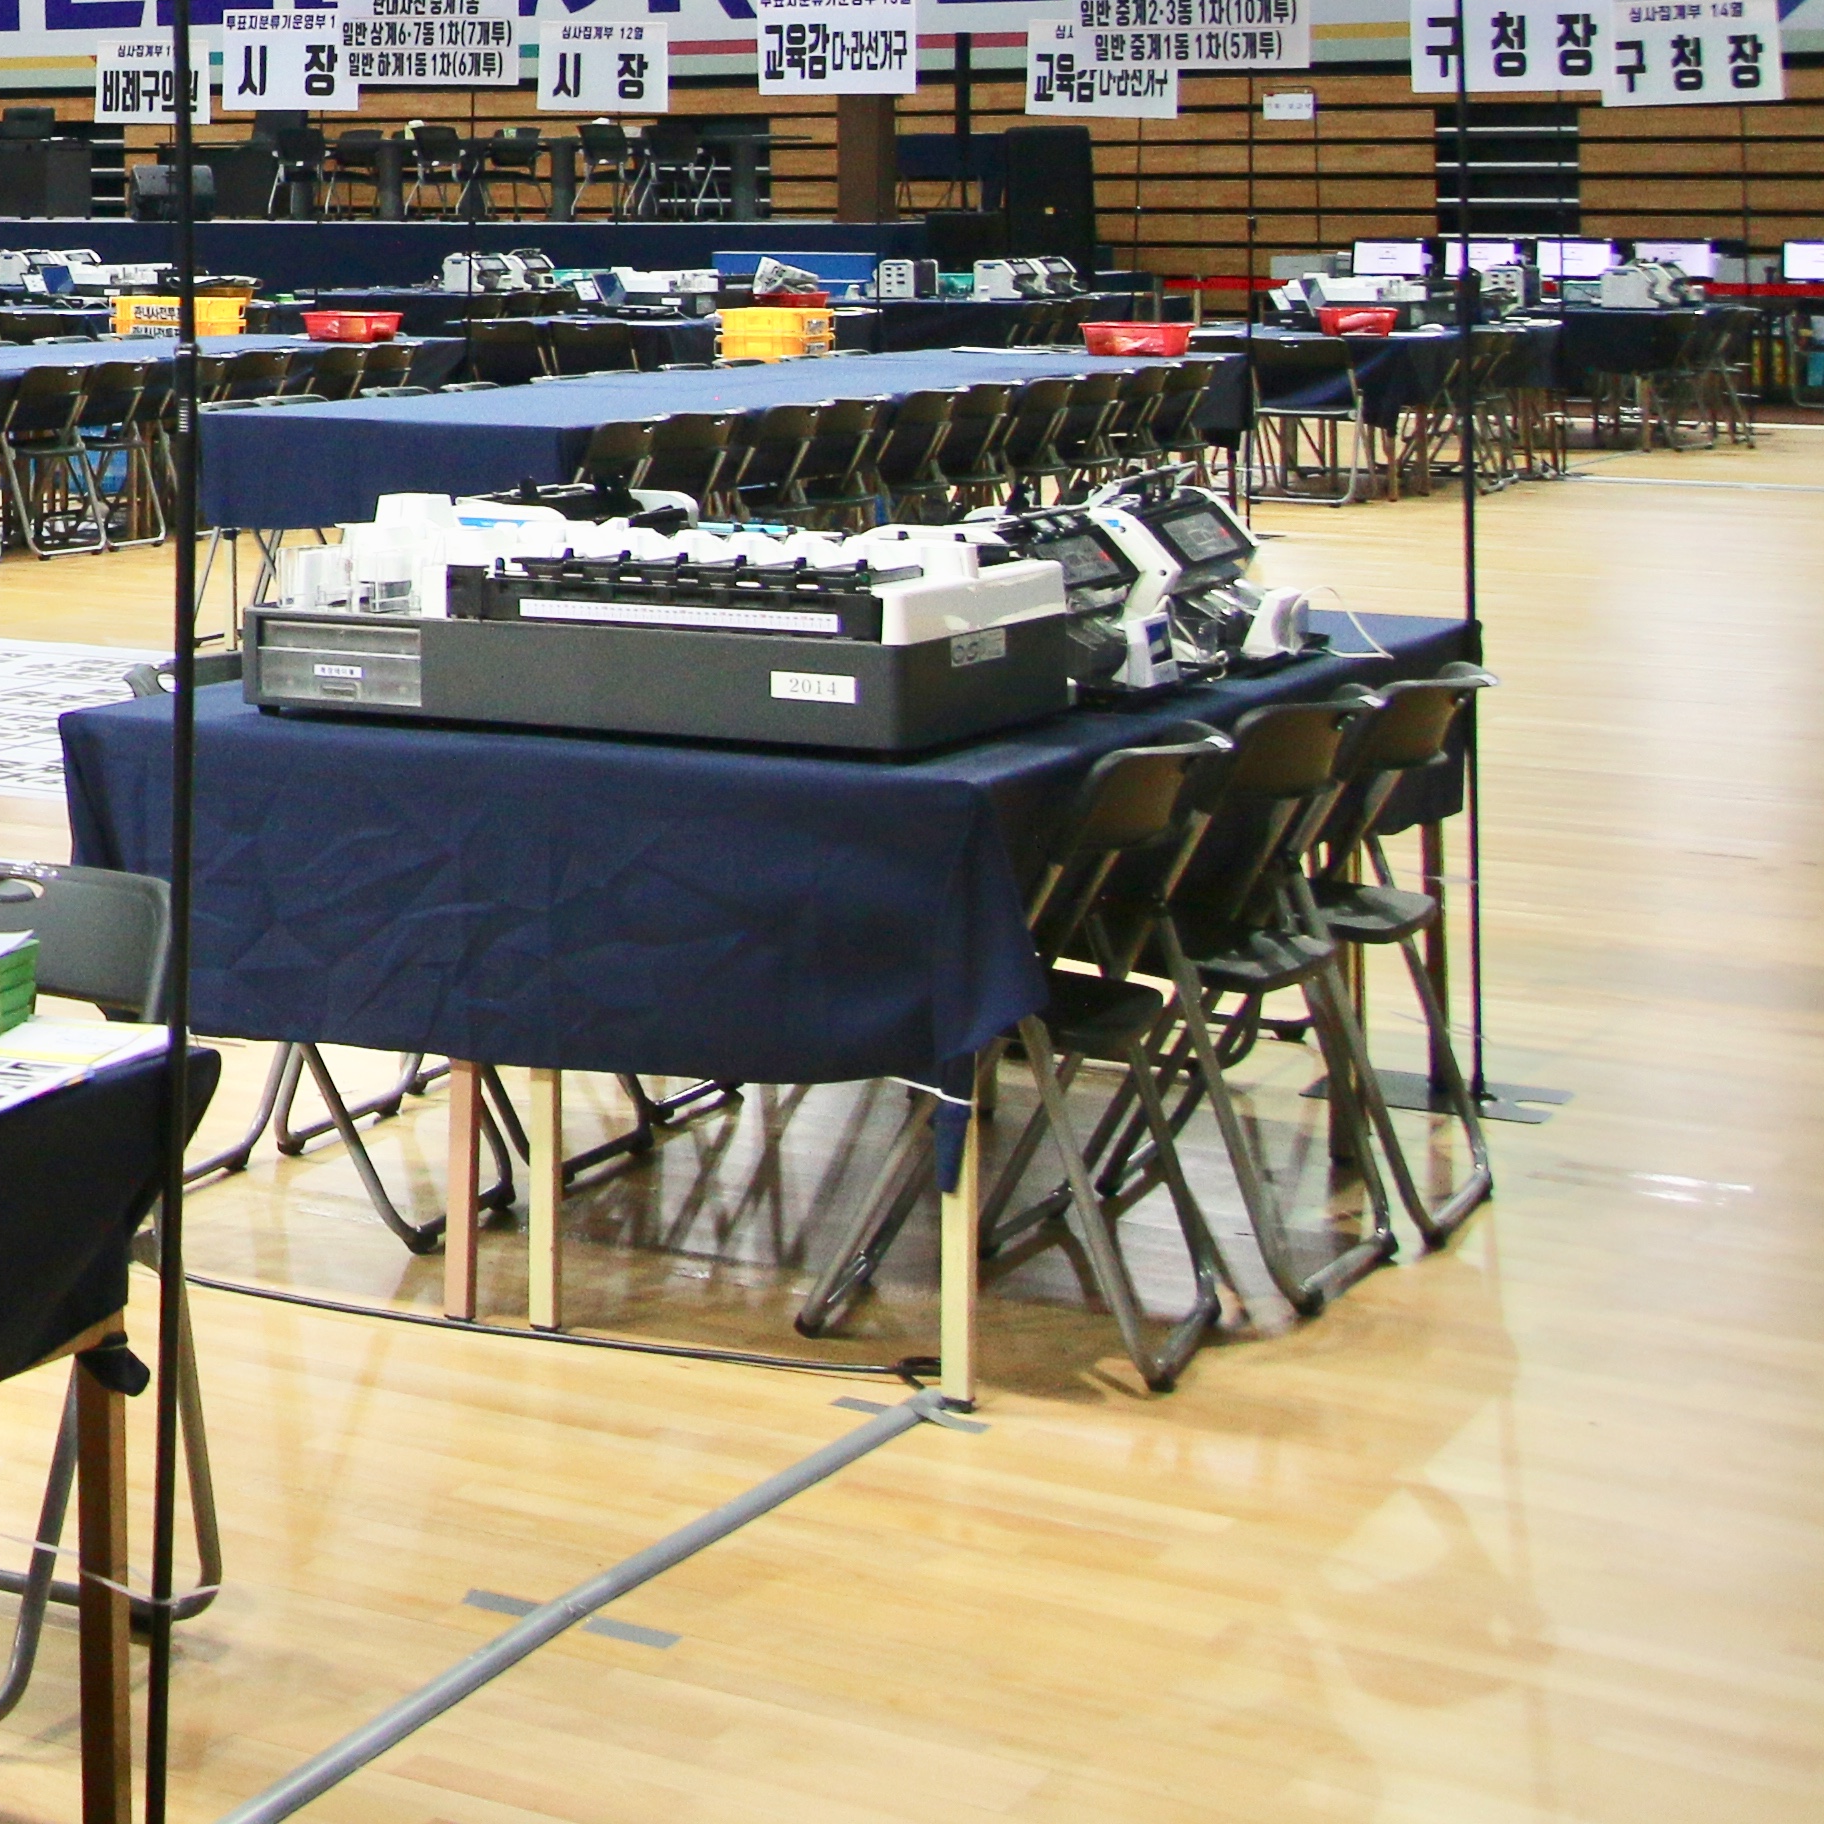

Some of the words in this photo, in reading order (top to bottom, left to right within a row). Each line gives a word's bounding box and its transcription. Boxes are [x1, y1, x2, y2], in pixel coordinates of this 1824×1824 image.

[227, 15, 326, 30] 투표지분류기운영부
[1081, 0, 1111, 27] 일반
[1629, 3, 1702, 23] 심사집계부
[1711, 1, 1744, 18] 14열
[342, 22, 367, 45] 일반
[439, 21, 512, 47] 1차(7개투)
[562, 26, 614, 40] 심사집계부
[620, 26, 644, 40] 12열
[1095, 34, 1125, 61] 일반
[1131, 32, 1189, 60] 중계1동
[1196, 29, 1282, 61] 1차(5개투)
[348, 53, 374, 77] 일반
[378, 53, 426, 77] 하계1동
[431, 52, 503, 79] 1차(6개투)
[789, 678, 837, 696] 2014
